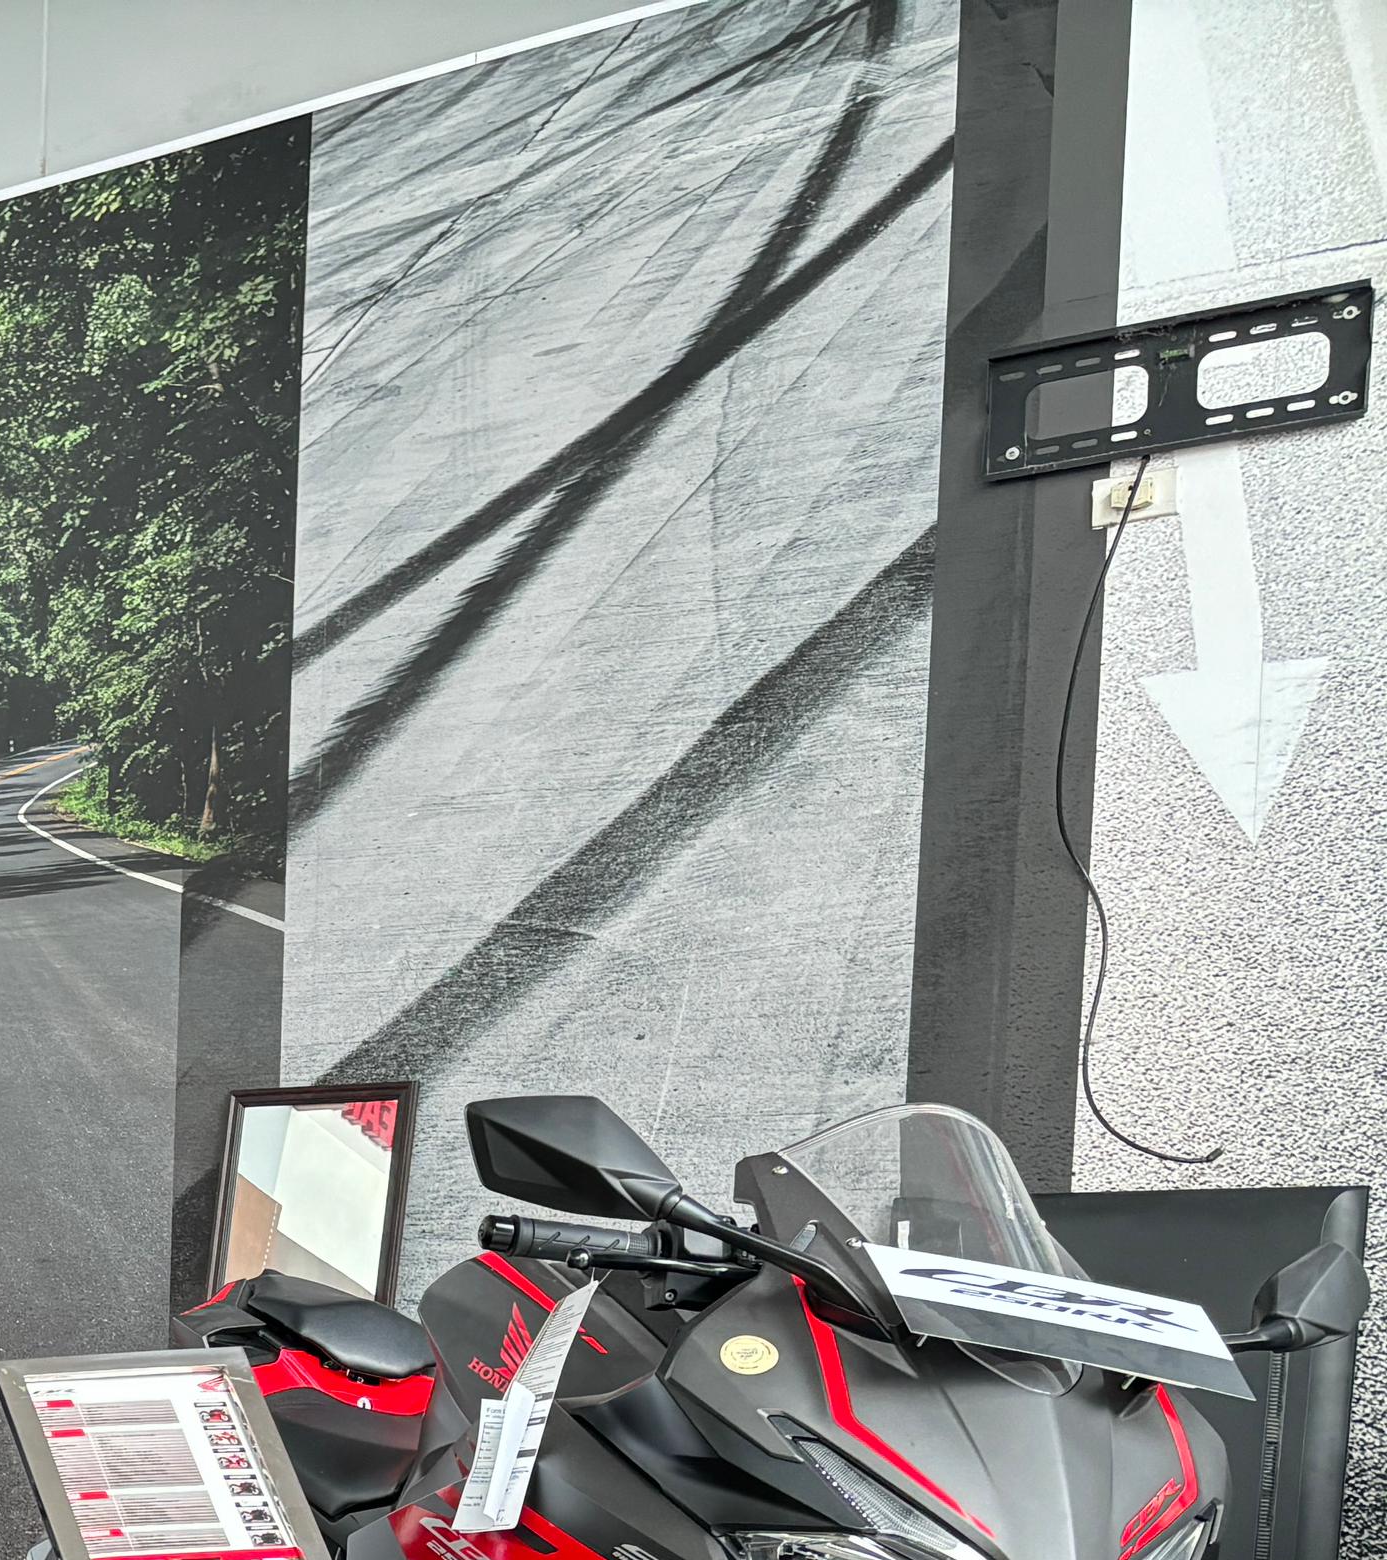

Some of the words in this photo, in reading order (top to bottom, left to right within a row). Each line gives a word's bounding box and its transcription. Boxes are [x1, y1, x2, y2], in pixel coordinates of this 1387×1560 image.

[899, 1268, 1199, 1333] CBR
[949, 1287, 1165, 1334] 250RR
[467, 1357, 510, 1393] HON
